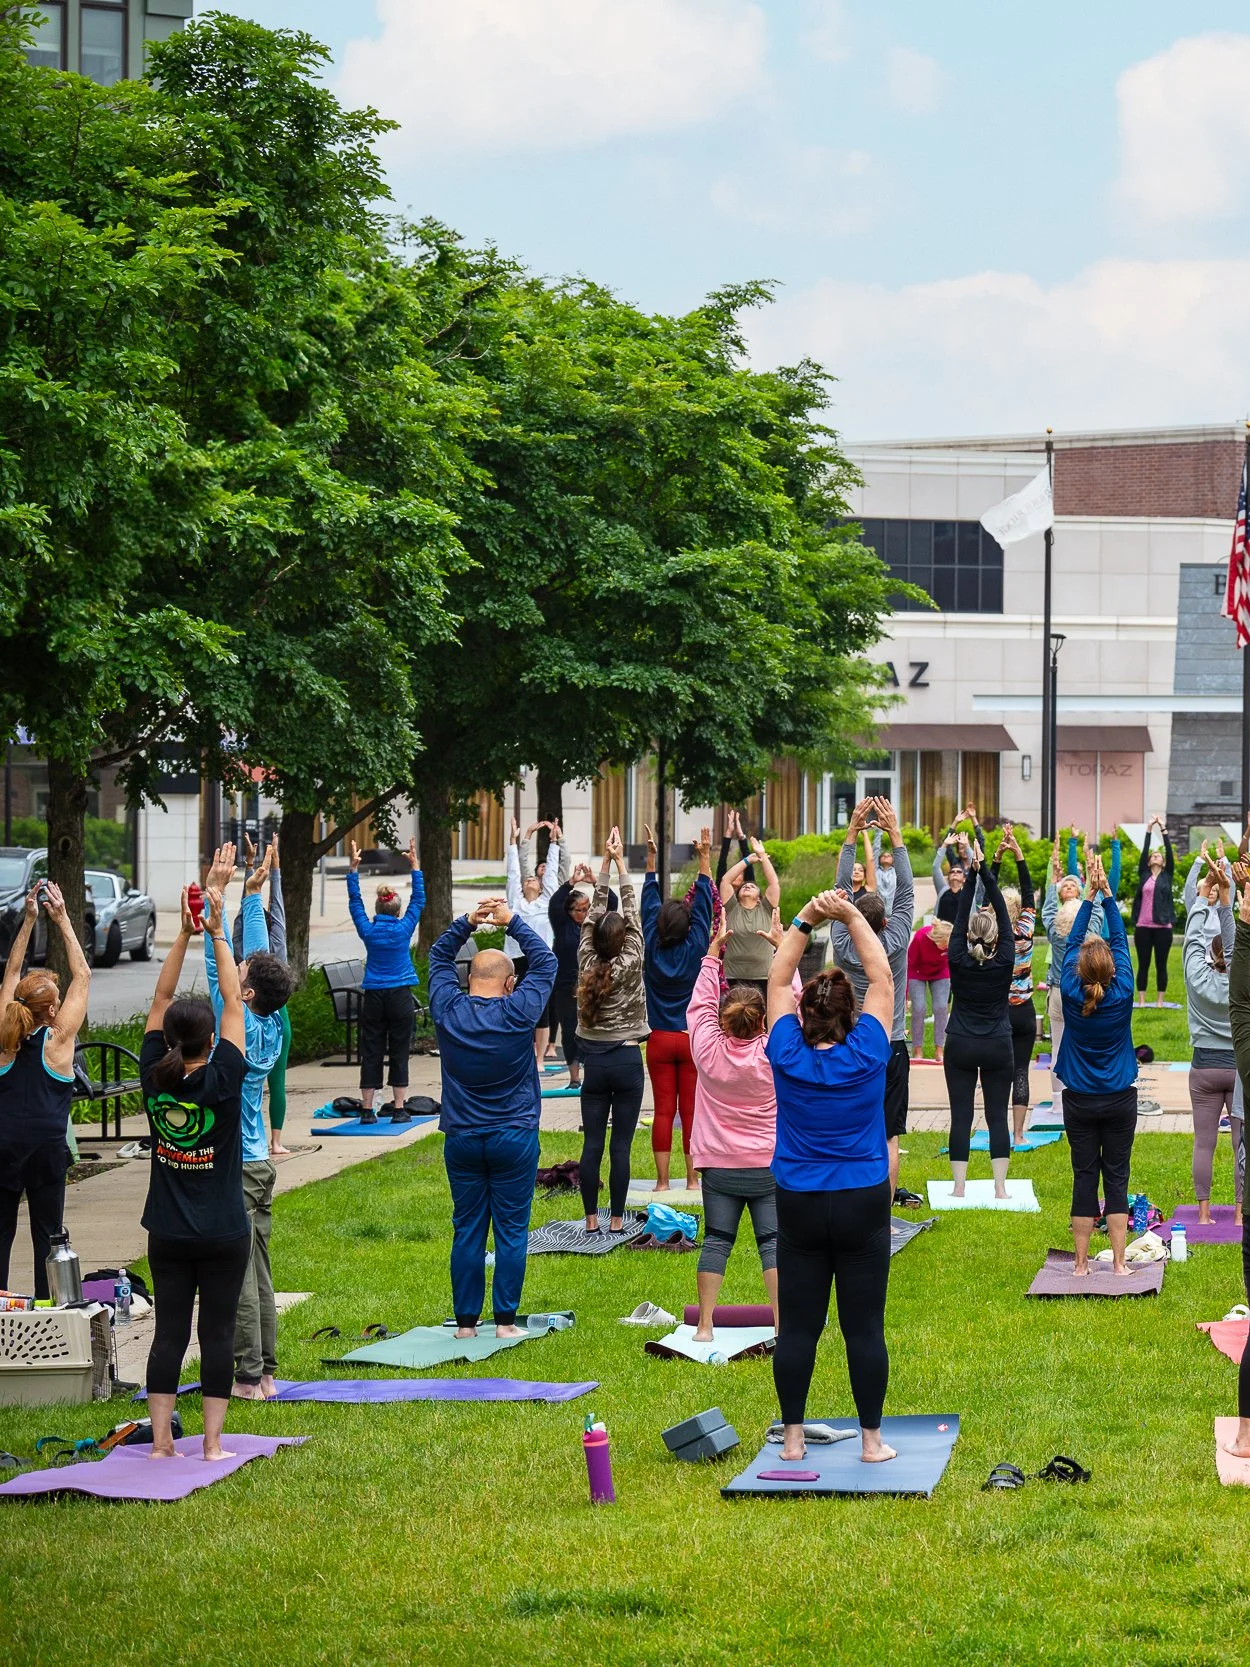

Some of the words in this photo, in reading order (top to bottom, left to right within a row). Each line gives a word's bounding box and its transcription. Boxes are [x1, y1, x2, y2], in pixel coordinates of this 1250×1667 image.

[1064, 763, 1133, 777] TOPAZ
[156, 1145, 214, 1164] MOVEMENT
[186, 1150, 197, 1158] OF
[199, 1146, 215, 1156] THE
[180, 1162, 214, 1170] HUNGER
